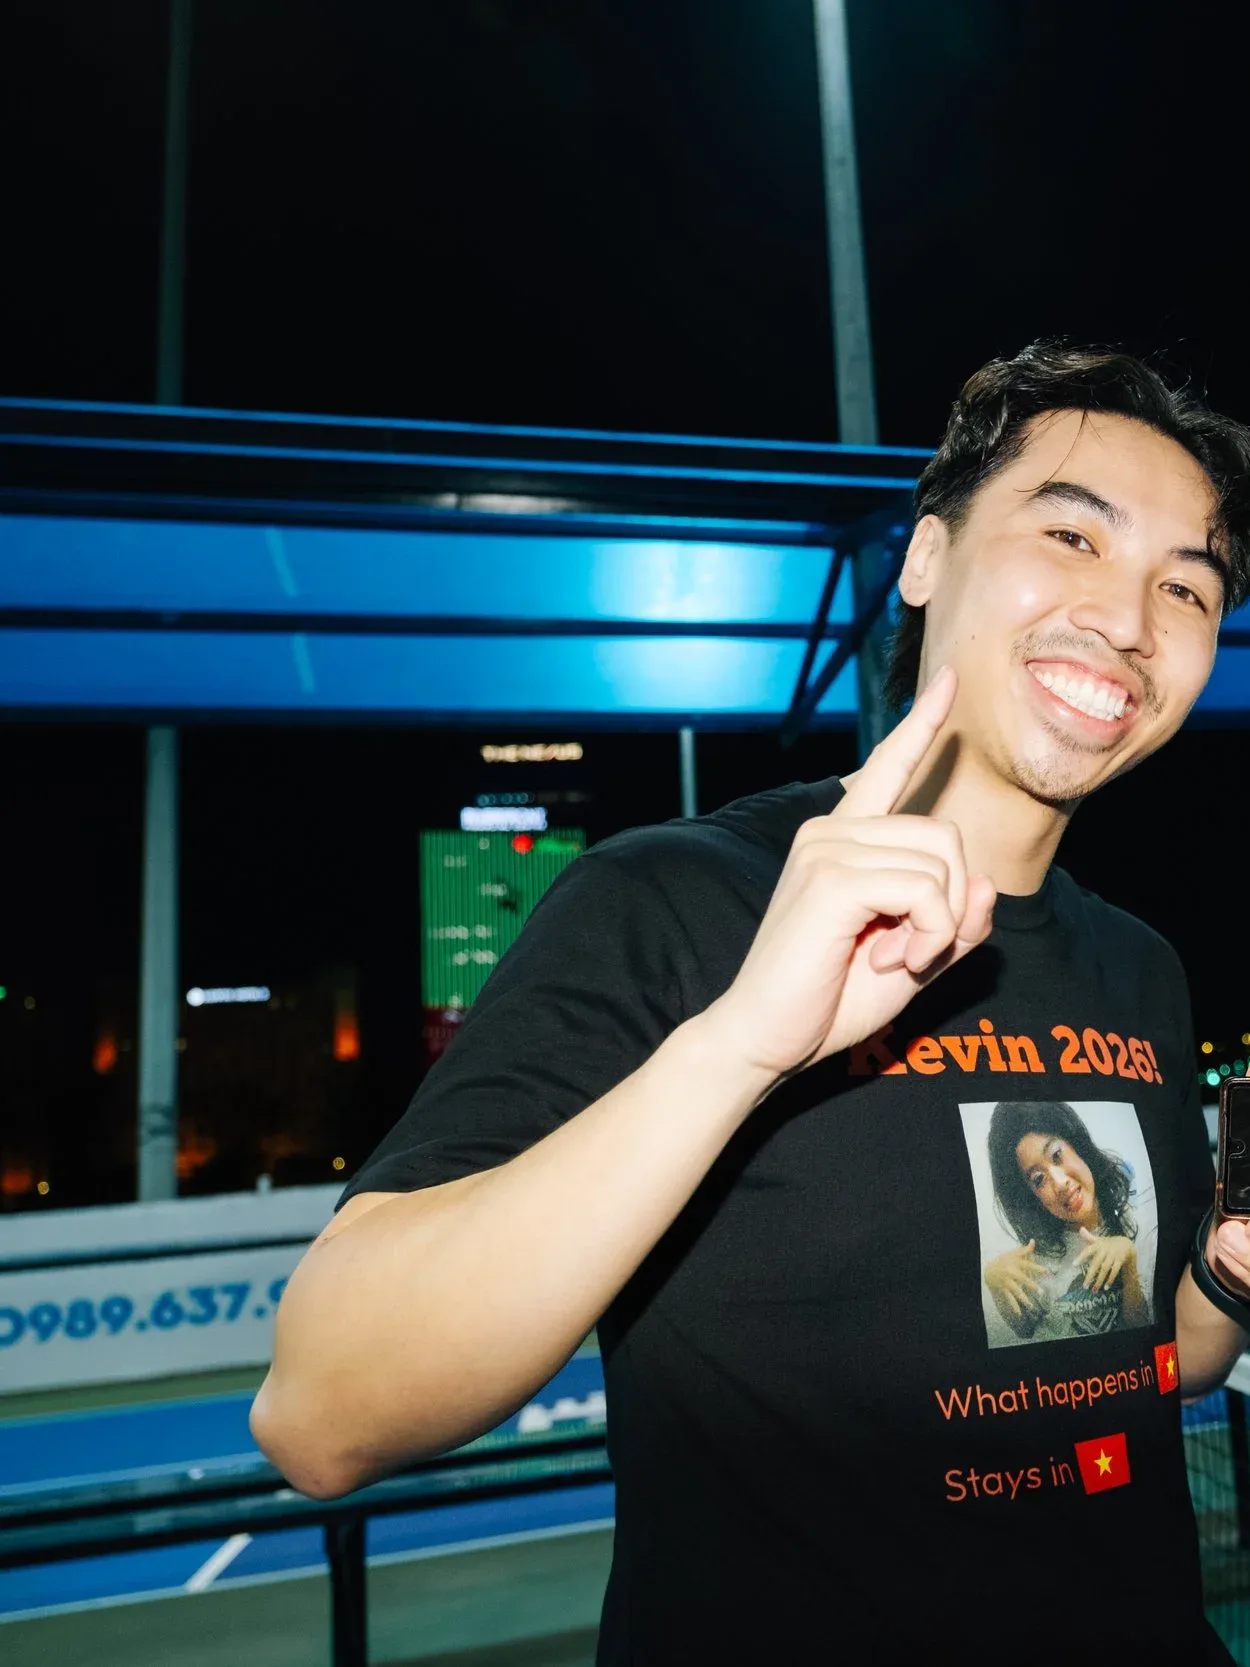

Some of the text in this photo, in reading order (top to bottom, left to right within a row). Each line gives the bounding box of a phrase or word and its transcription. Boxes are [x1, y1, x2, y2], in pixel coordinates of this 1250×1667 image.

[847, 1018, 1163, 1085] Kevin 2026!
[0, 1277, 288, 1347] 0989.637.
[934, 1360, 1155, 1420] What happens in
[944, 1457, 1075, 1502] Stays in
